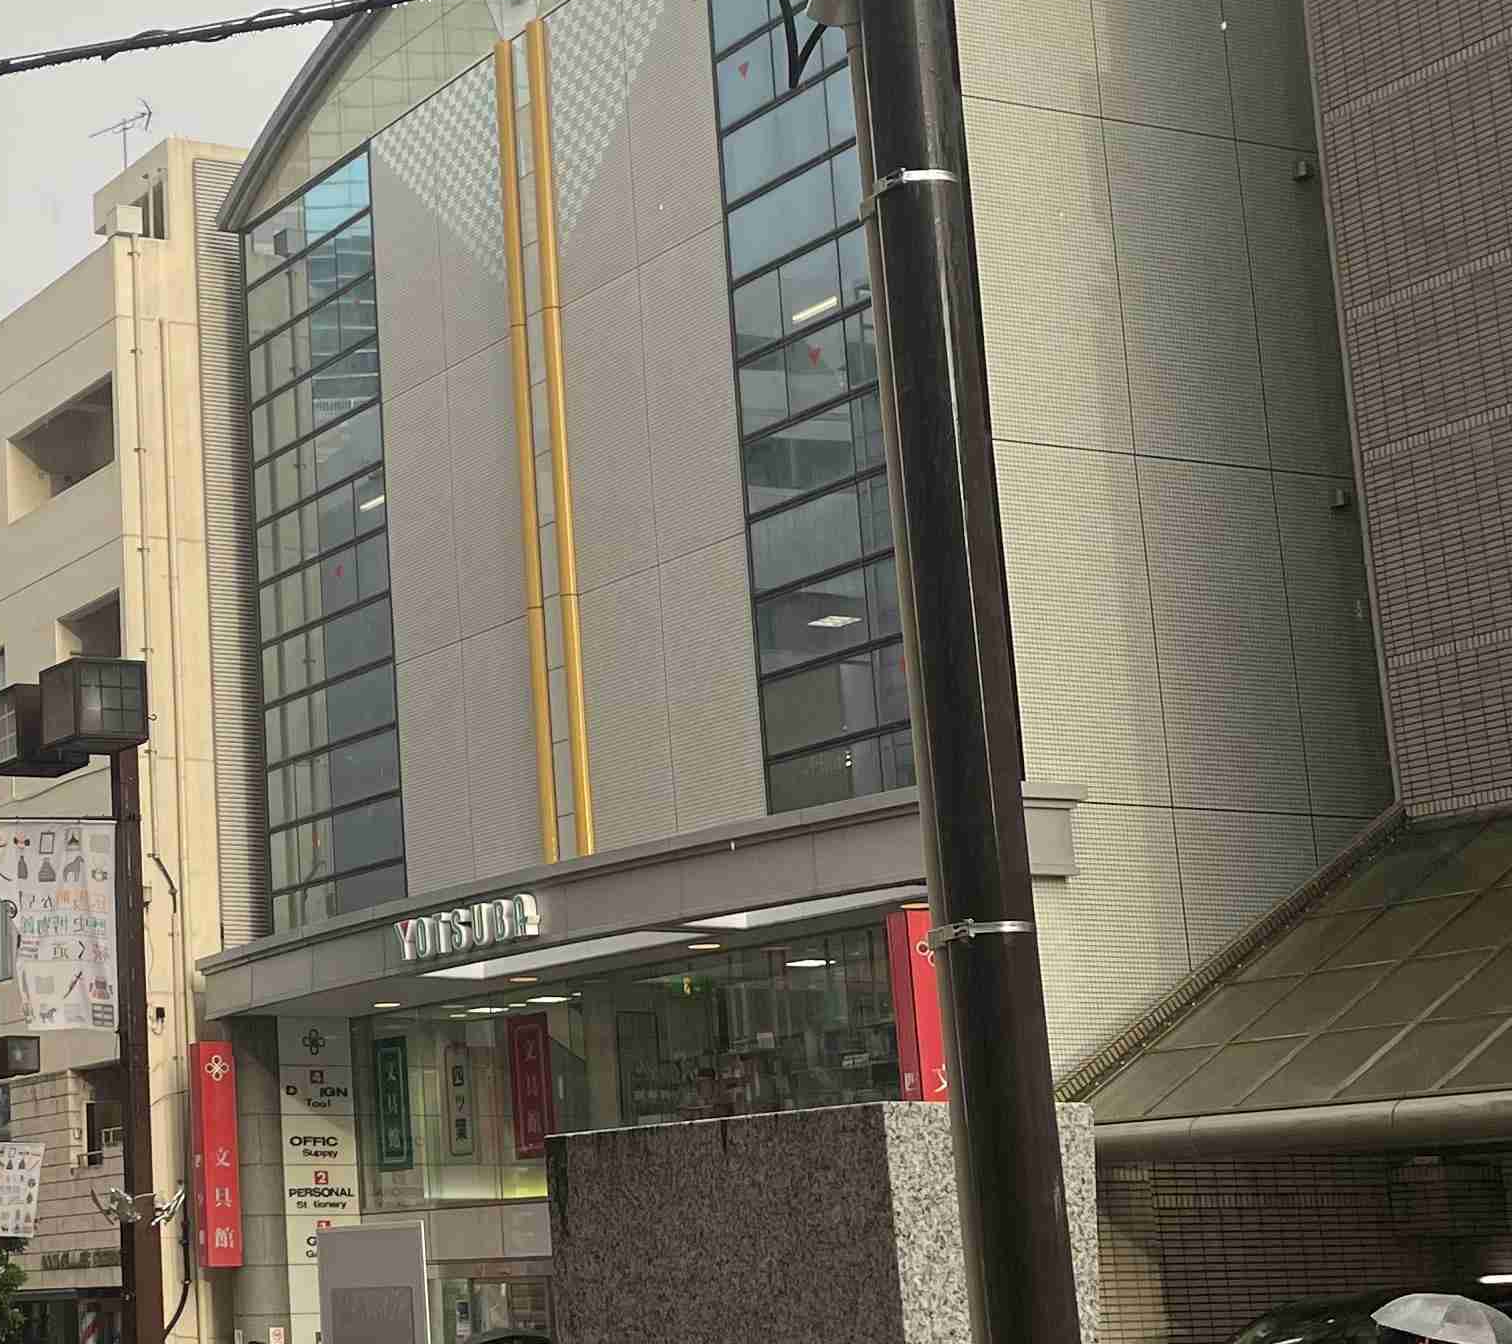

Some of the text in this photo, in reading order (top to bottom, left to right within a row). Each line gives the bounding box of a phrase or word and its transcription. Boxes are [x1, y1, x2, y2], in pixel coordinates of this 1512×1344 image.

[392, 893, 541, 961] YOTSUBA
[289, 1187, 355, 1198] PERSONAL
[317, 1171, 326, 1183] 2
[215, 1147, 234, 1249] 文具館
